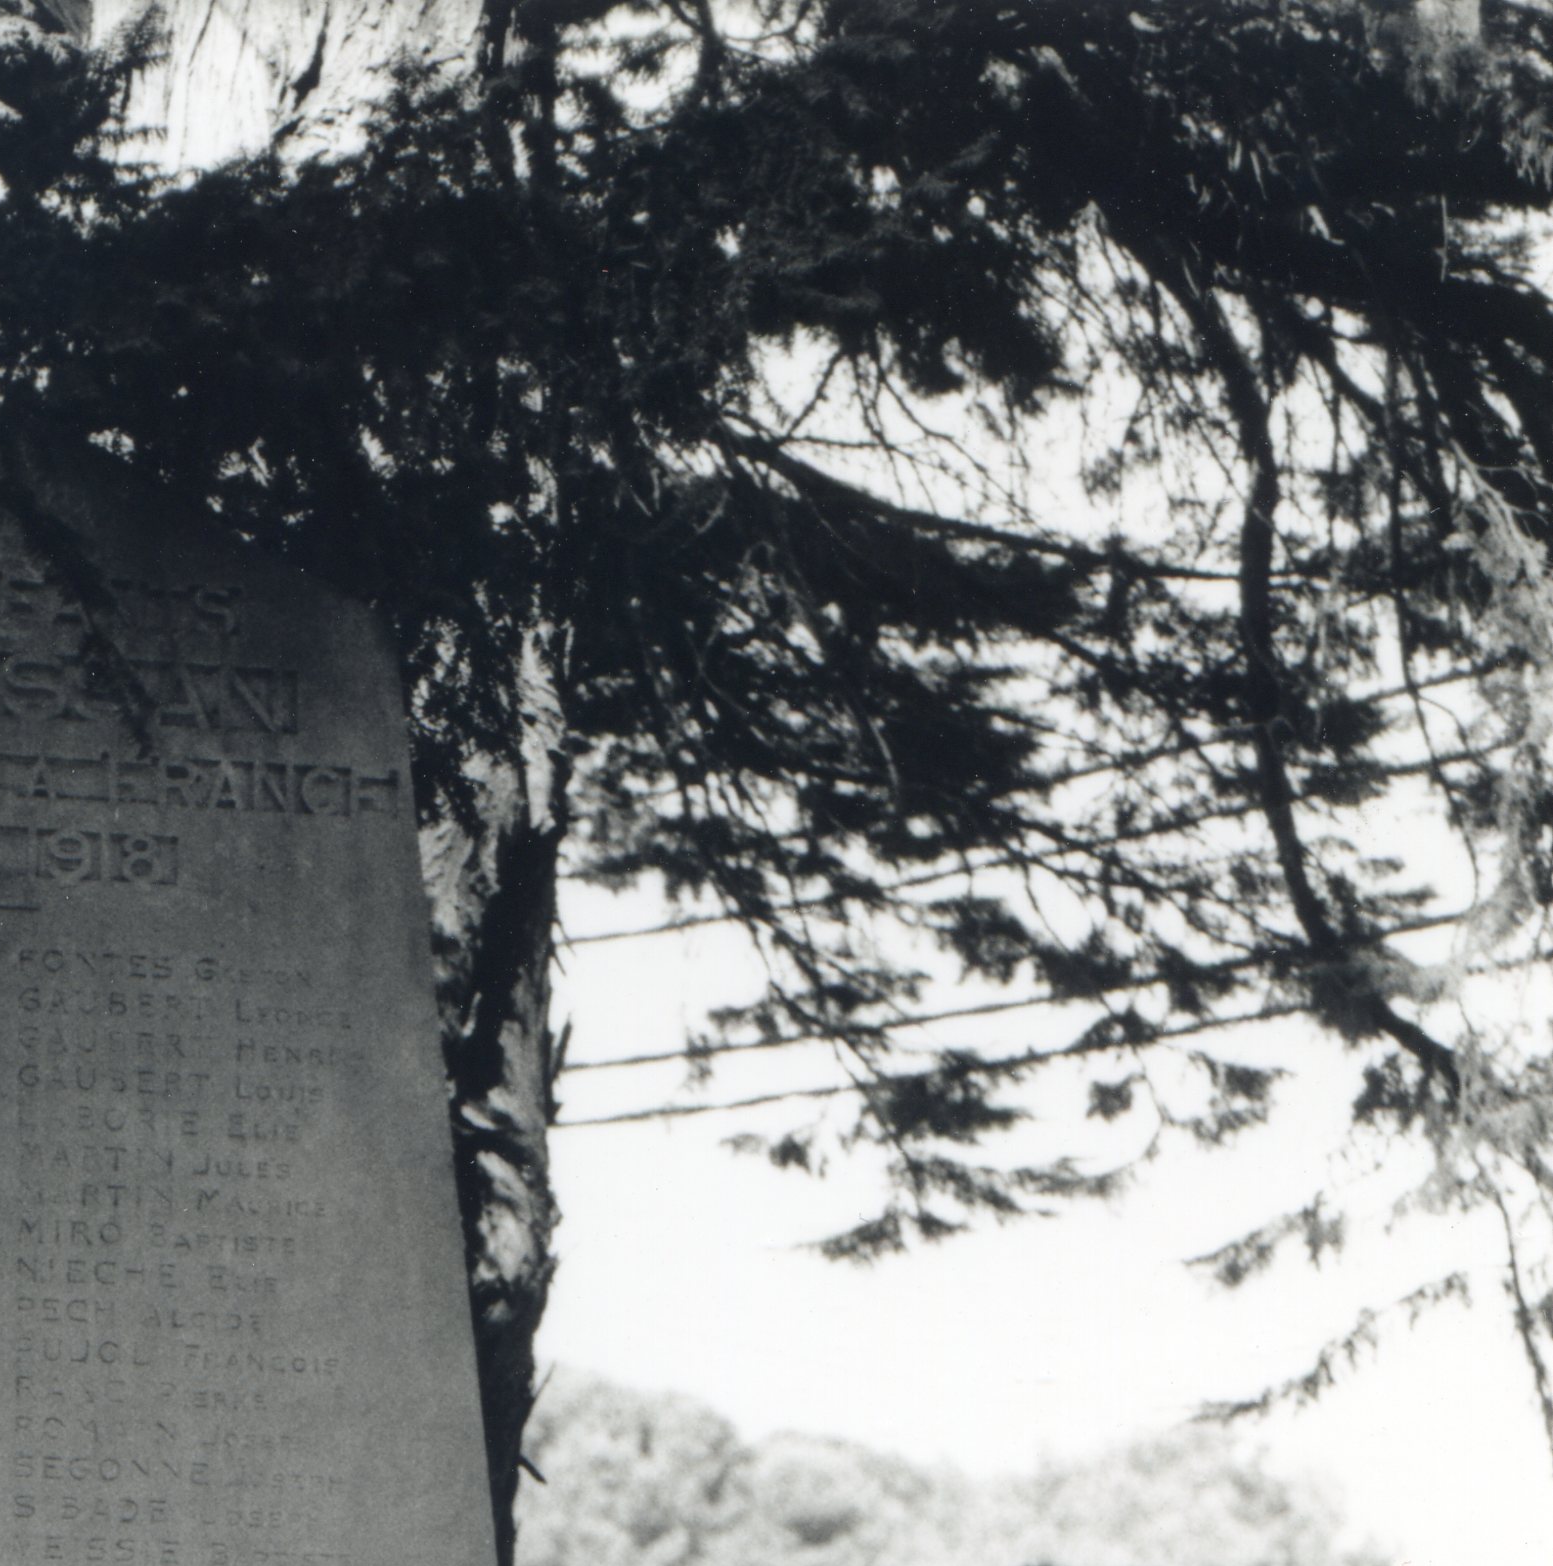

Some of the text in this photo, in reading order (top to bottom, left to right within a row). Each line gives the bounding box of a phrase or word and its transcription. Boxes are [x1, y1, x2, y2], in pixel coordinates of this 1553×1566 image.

[103, 755, 398, 818] FRANCE
[24, 824, 162, 885] 1918
[192, 1153, 292, 1181] JULES
